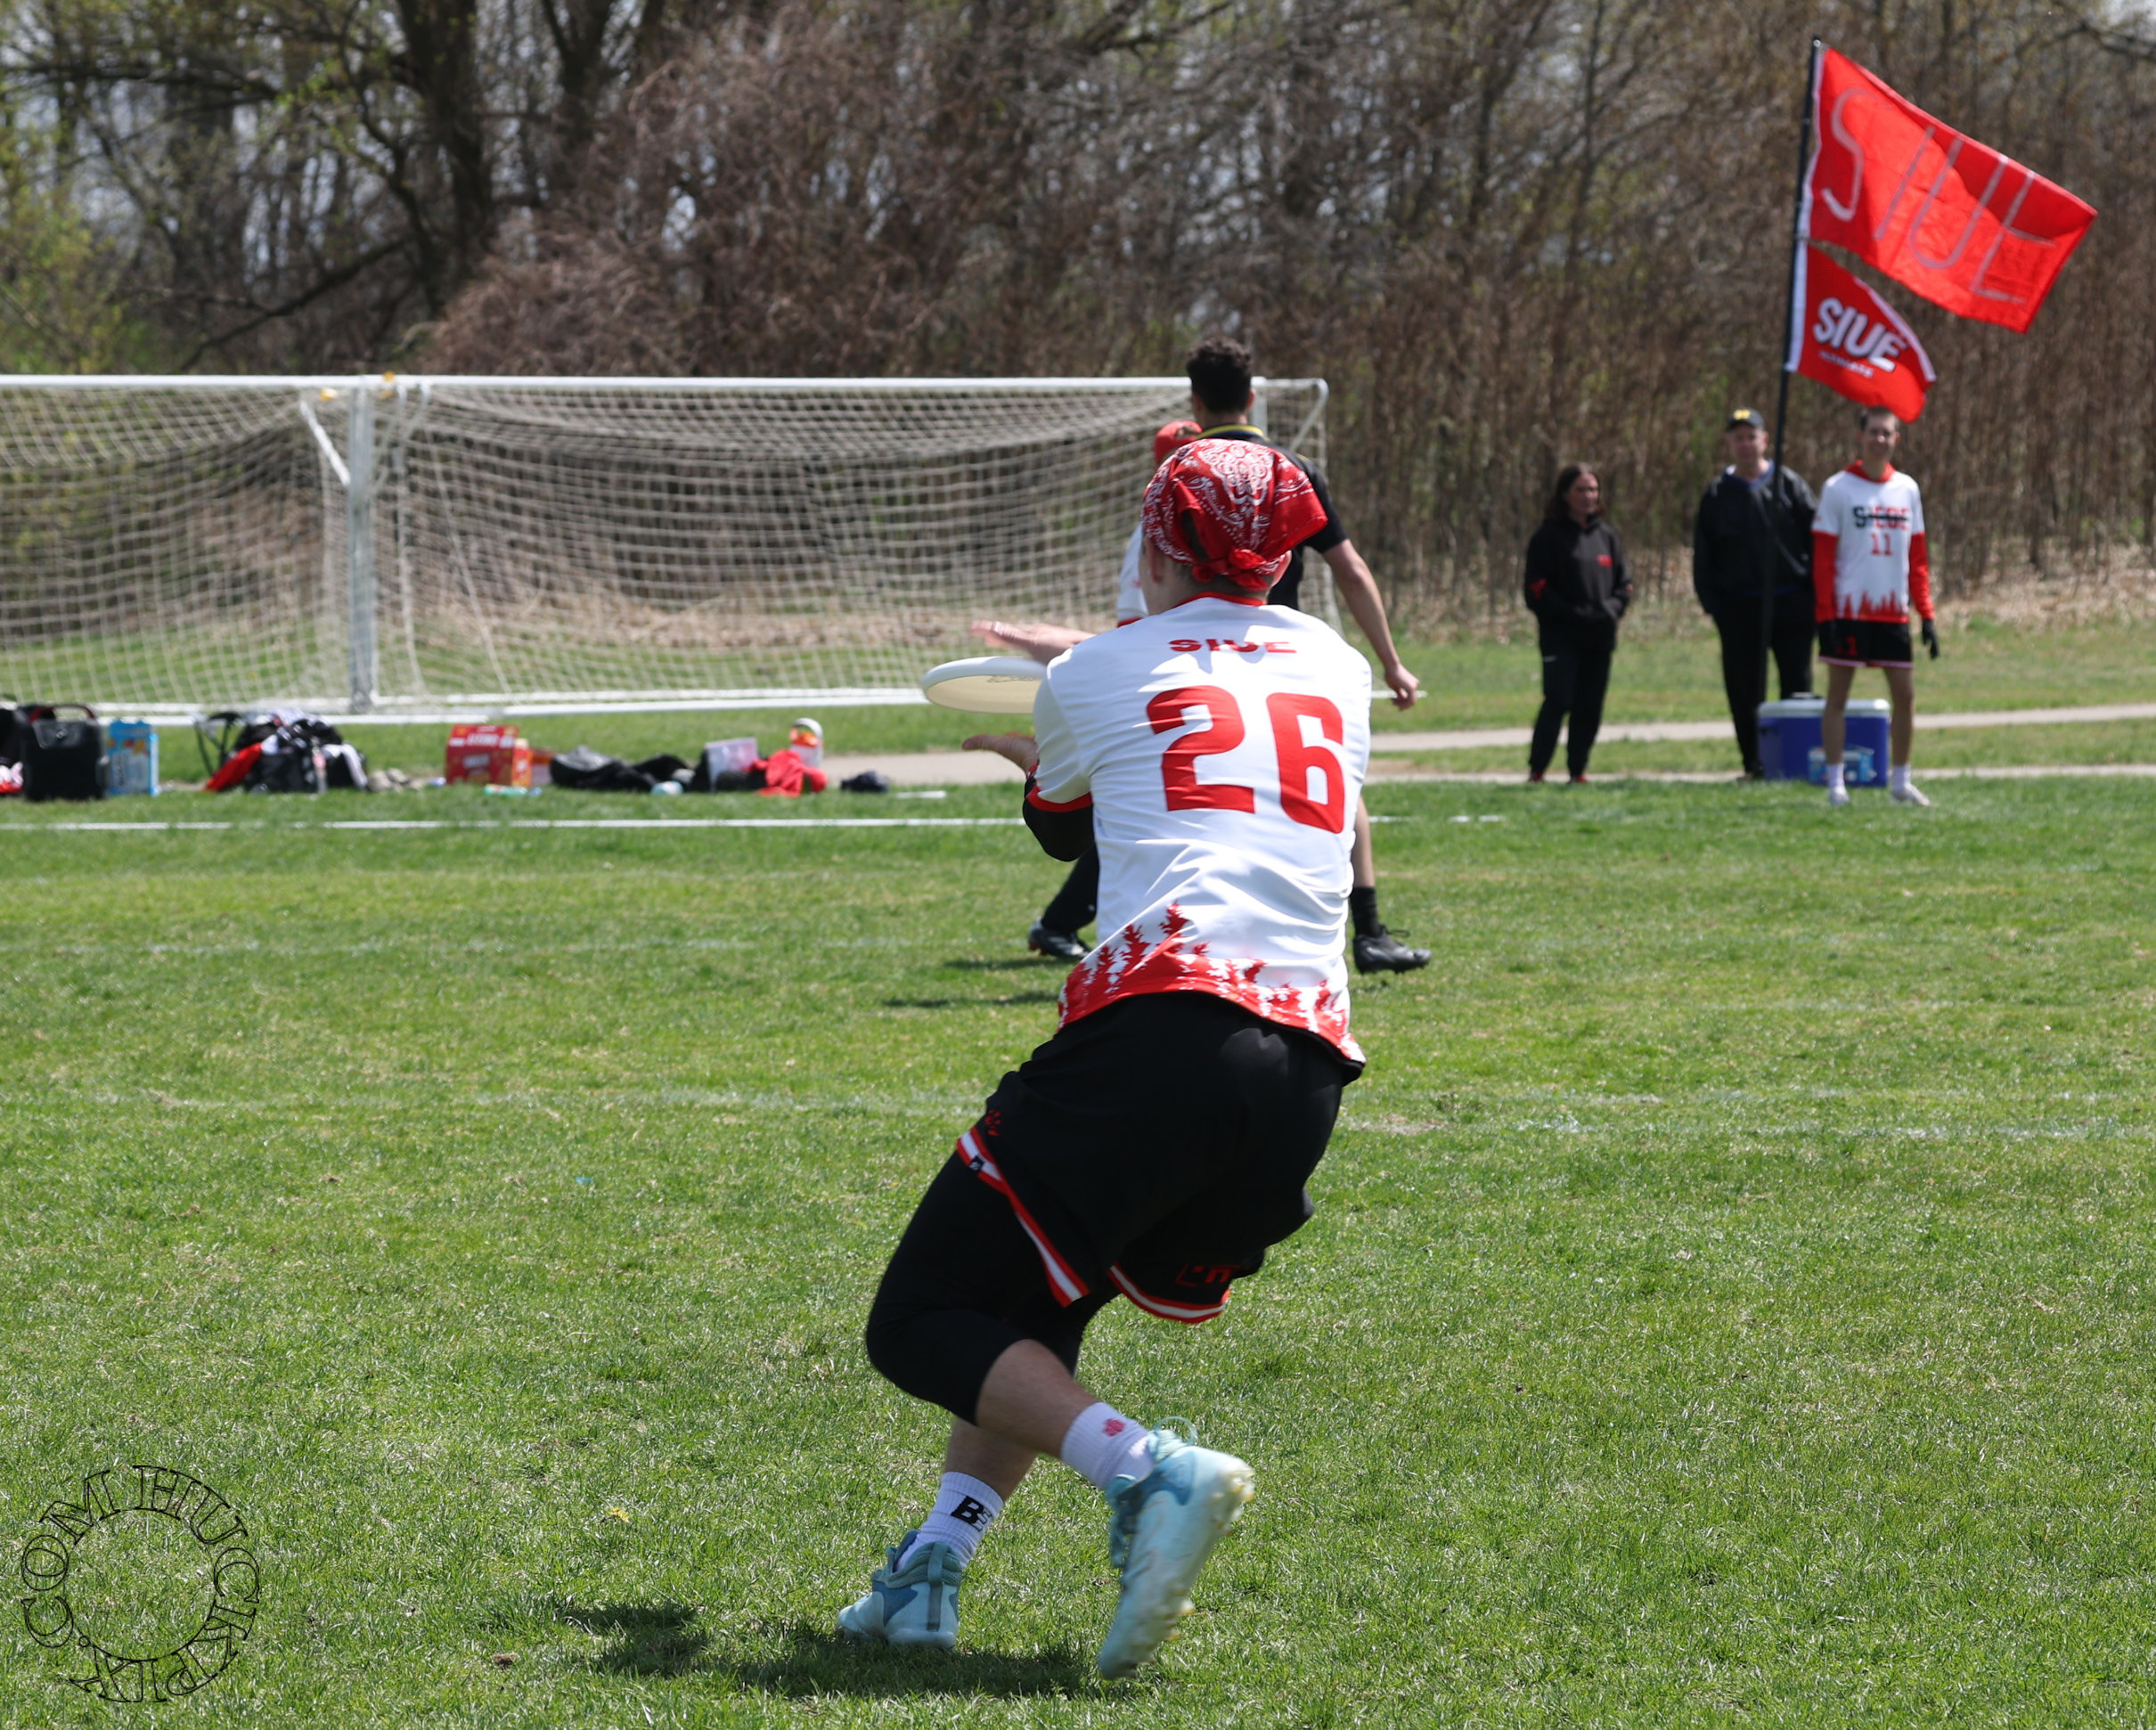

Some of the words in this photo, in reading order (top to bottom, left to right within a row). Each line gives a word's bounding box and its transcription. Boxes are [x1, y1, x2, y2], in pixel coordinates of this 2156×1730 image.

[1812, 297, 1908, 372] SIUE
[1870, 532, 1894, 557] 11
[1168, 639, 1298, 653] SIUE
[1146, 684, 1345, 835] 26
